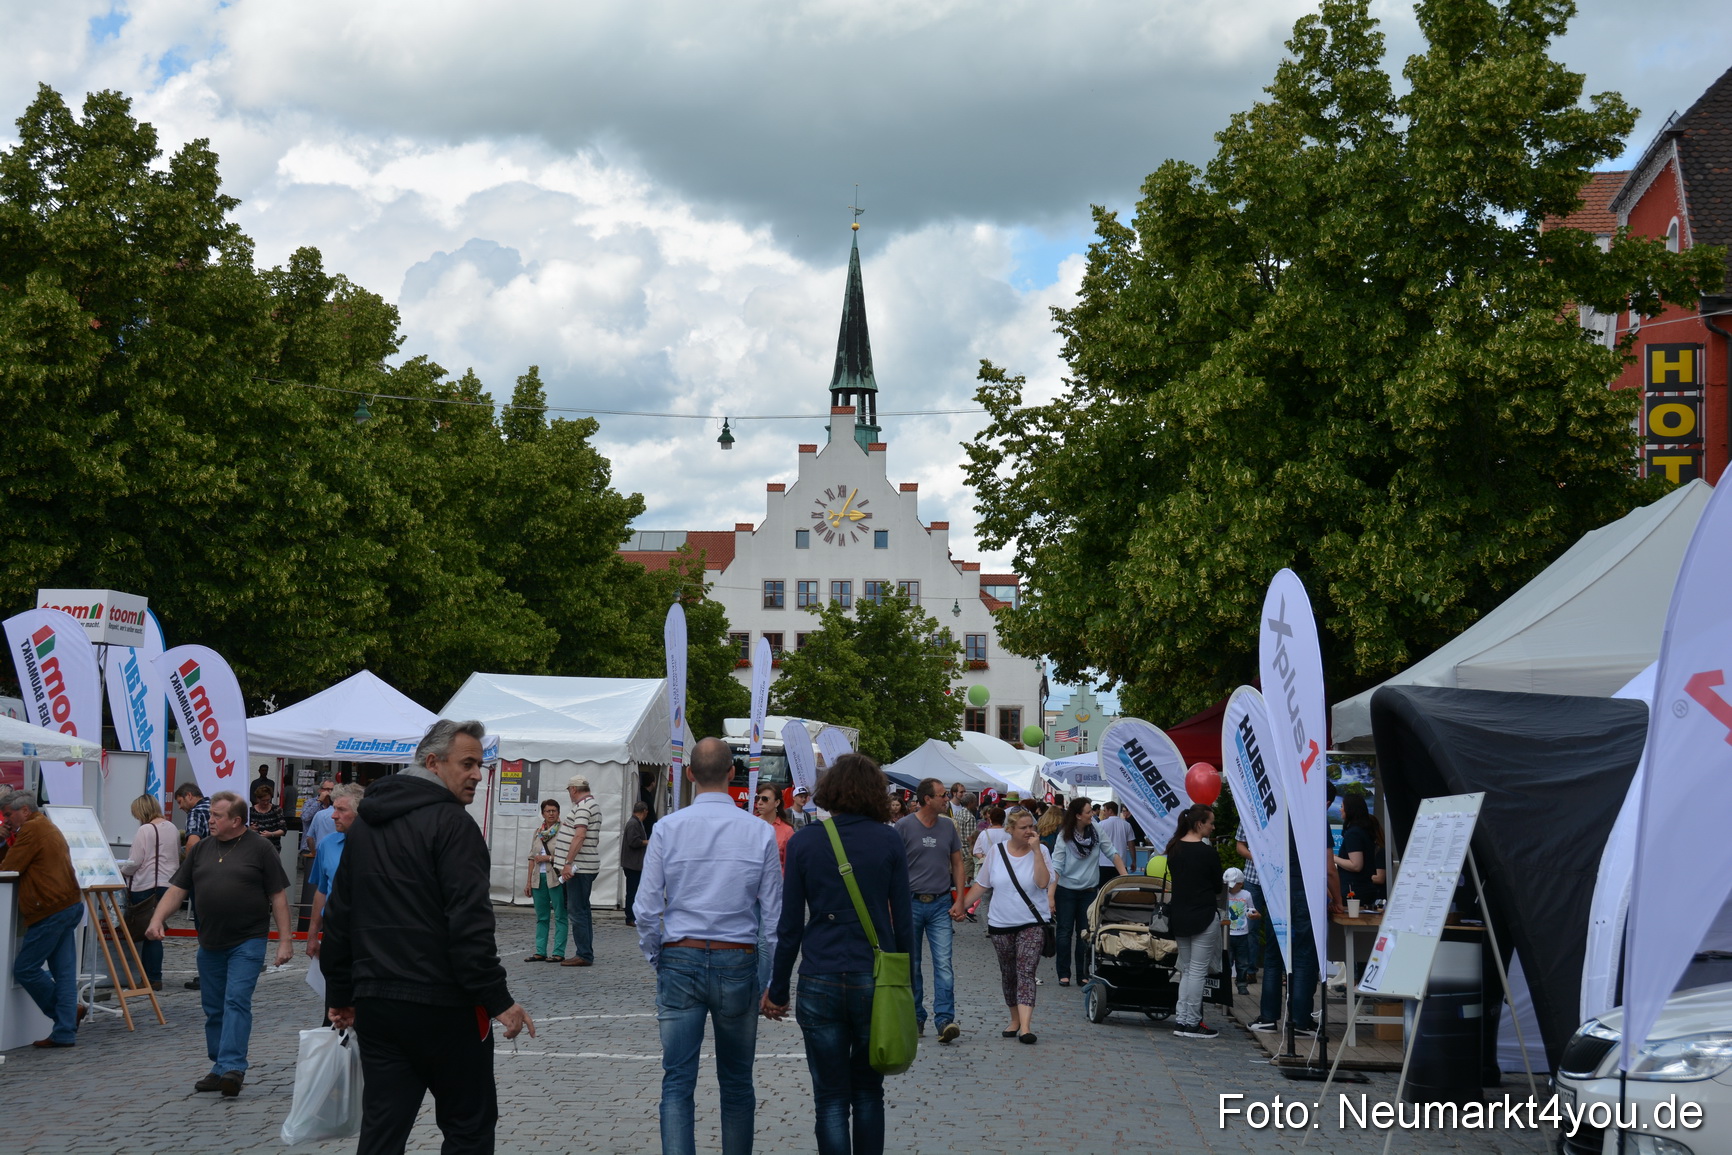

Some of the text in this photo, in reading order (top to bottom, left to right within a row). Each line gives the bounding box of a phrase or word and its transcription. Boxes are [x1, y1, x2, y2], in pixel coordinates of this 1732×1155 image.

[109, 604, 138, 625] toom
[336, 738, 417, 753] slackstar
[1119, 766, 1133, 783] WASTE
[1131, 783, 1144, 800] WATER
[1123, 737, 1180, 813] HUBER
[1126, 761, 1165, 814] TECHNOLOGY
[1238, 713, 1277, 822] HUBER
[1240, 750, 1266, 822] TECHNOLOGY
[1364, 964, 1380, 984] 27
